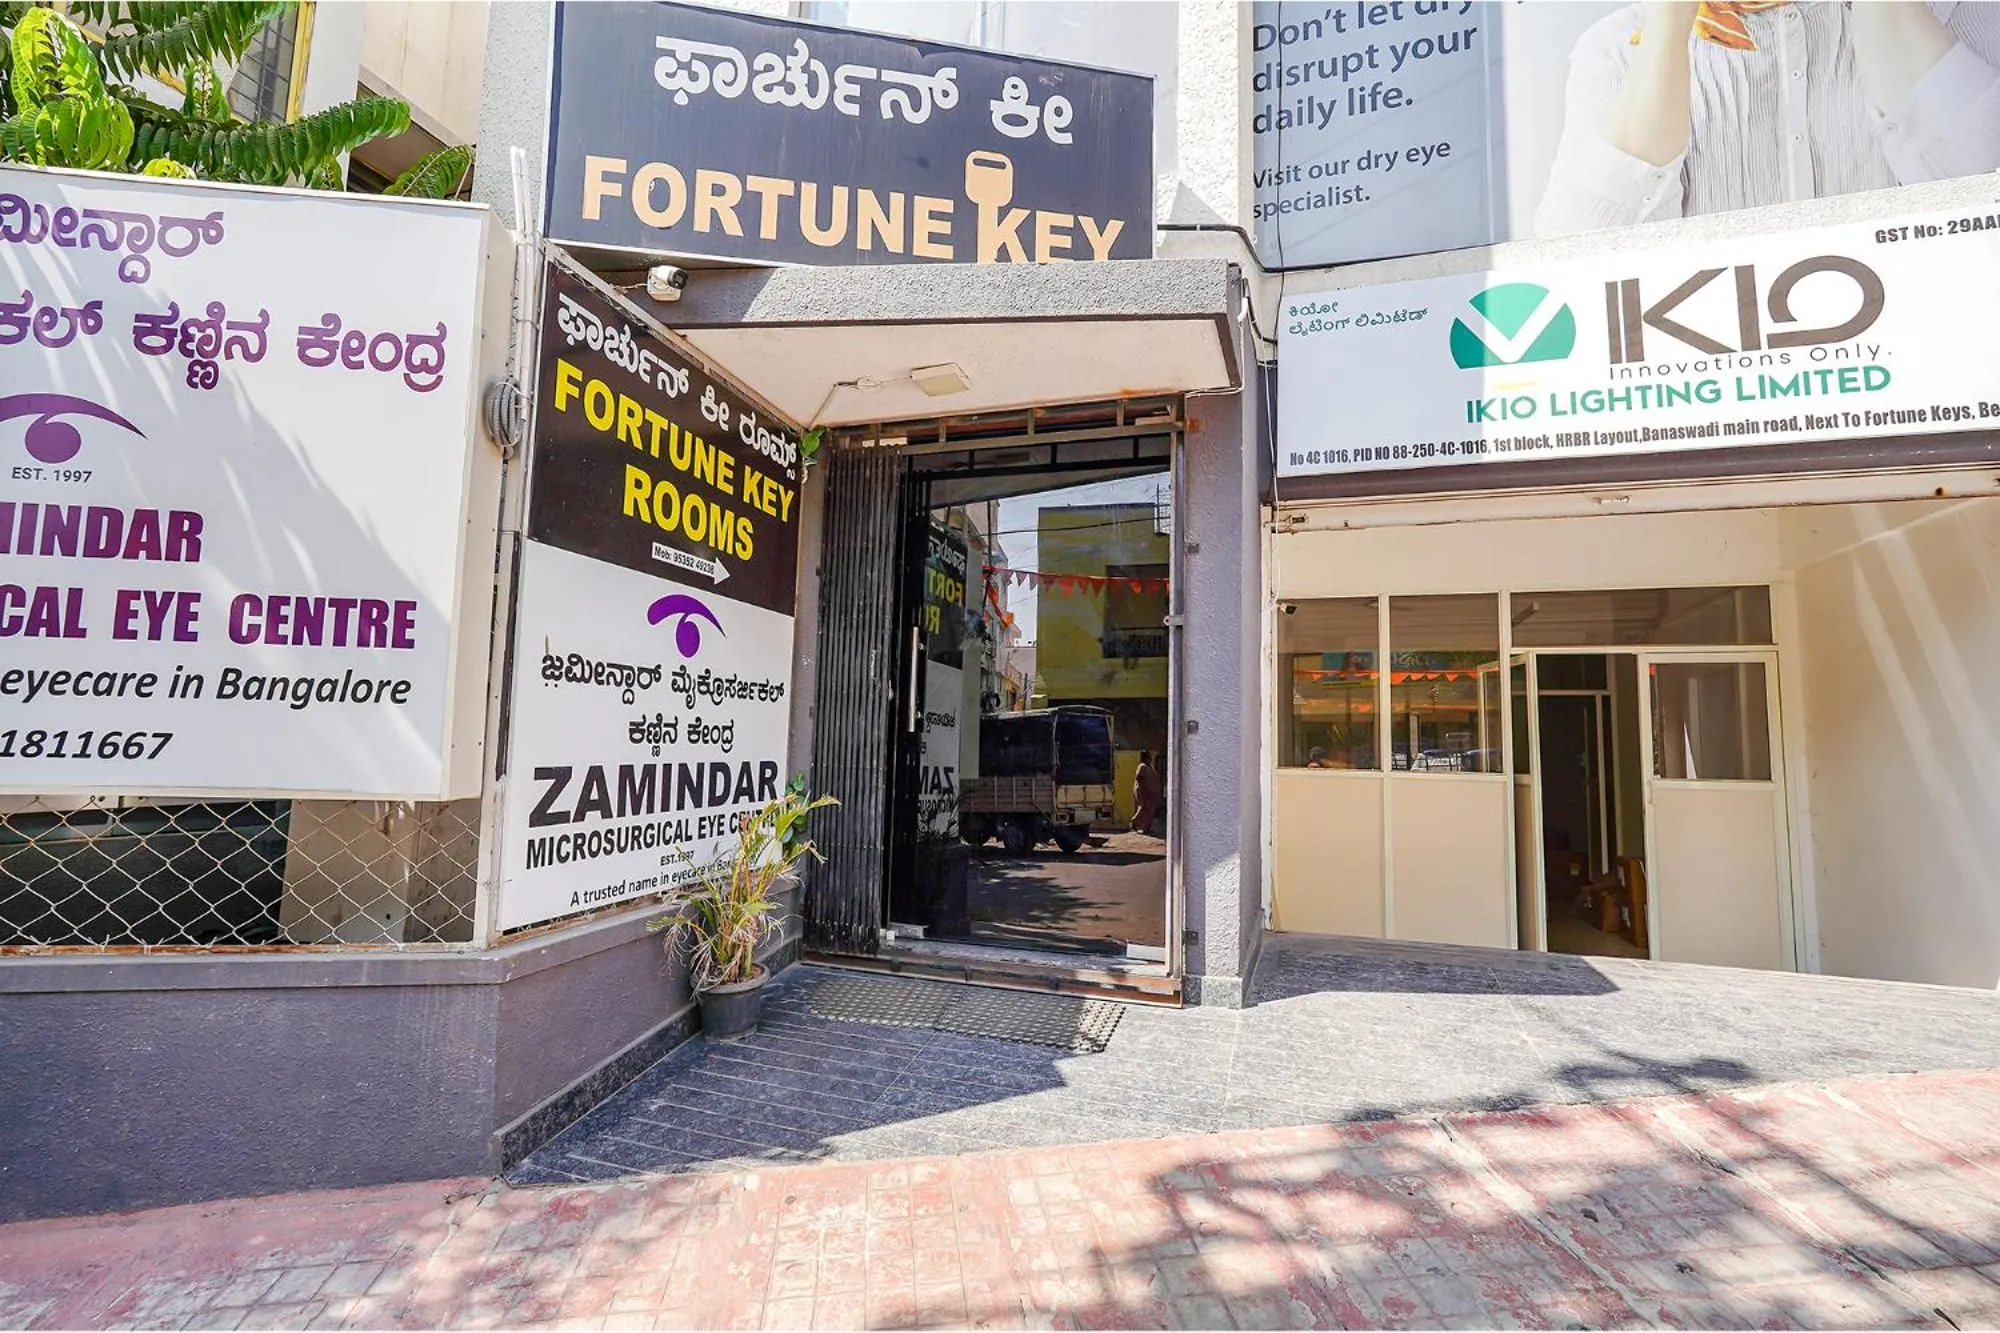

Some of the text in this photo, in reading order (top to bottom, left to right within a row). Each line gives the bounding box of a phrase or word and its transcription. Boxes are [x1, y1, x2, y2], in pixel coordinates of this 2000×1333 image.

[1253, 1, 1403, 52] Don't let
[1253, 27, 1477, 92] disrupt your
[990, 74, 1074, 145] ಕೀ
[1253, 81, 1413, 134] daily life.
[1253, 142, 1452, 189] Visit our dry eye
[581, 154, 1126, 263] FORTUNE KEY
[1253, 184, 1371, 222] specialist.
[1875, 213, 2000, 244] GST No: 29AA
[132, 300, 270, 390] ಕಣ್ಣಿನ
[296, 312, 448, 393] ಕೇಂದ್ರ
[1609, 342, 1892, 380] Innovations Only.
[700, 384, 730, 432] ಕೀ
[1466, 365, 1892, 424] IKIO LIGHTING LIMITED
[554, 357, 795, 524] FORTUNE KEY
[1290, 452, 1304, 466] No
[1306, 450, 1321, 465] 4C
[1353, 447, 1372, 463] PID
[1375, 446, 1390, 461] NO
[1494, 438, 1512, 453] 1st
[1514, 434, 1553, 451] block,
[1556, 431, 1590, 448] HRBR
[1594, 421, 1720, 446] Layout,Banaswadi
[1723, 419, 1760, 436] main
[1763, 415, 1802, 433] road,
[1805, 413, 1839, 431] Next
[1841, 411, 1861, 428] To
[1864, 407, 1927, 427] Fortune
[1930, 405, 1976, 421] Keys,
[1978, 401, 2000, 418] Be
[11, 467, 93, 484] EST. 1997
[622, 463, 754, 561] ROOMS
[655, 545, 672, 561] Mob:
[0, 584, 417, 649] CAL EYE CENTRE
[0, 665, 412, 710] eyecare in Bangalore
[0, 729, 173, 760] 1811667
[528, 760, 778, 828] ZAMINDAR
[526, 824, 693, 869] MICROSURGICAL
[698, 814, 725, 840] EYE
[570, 891, 580, 907] A
[583, 879, 626, 904] trusted
[628, 876, 658, 892] name
[660, 872, 669, 886] in
